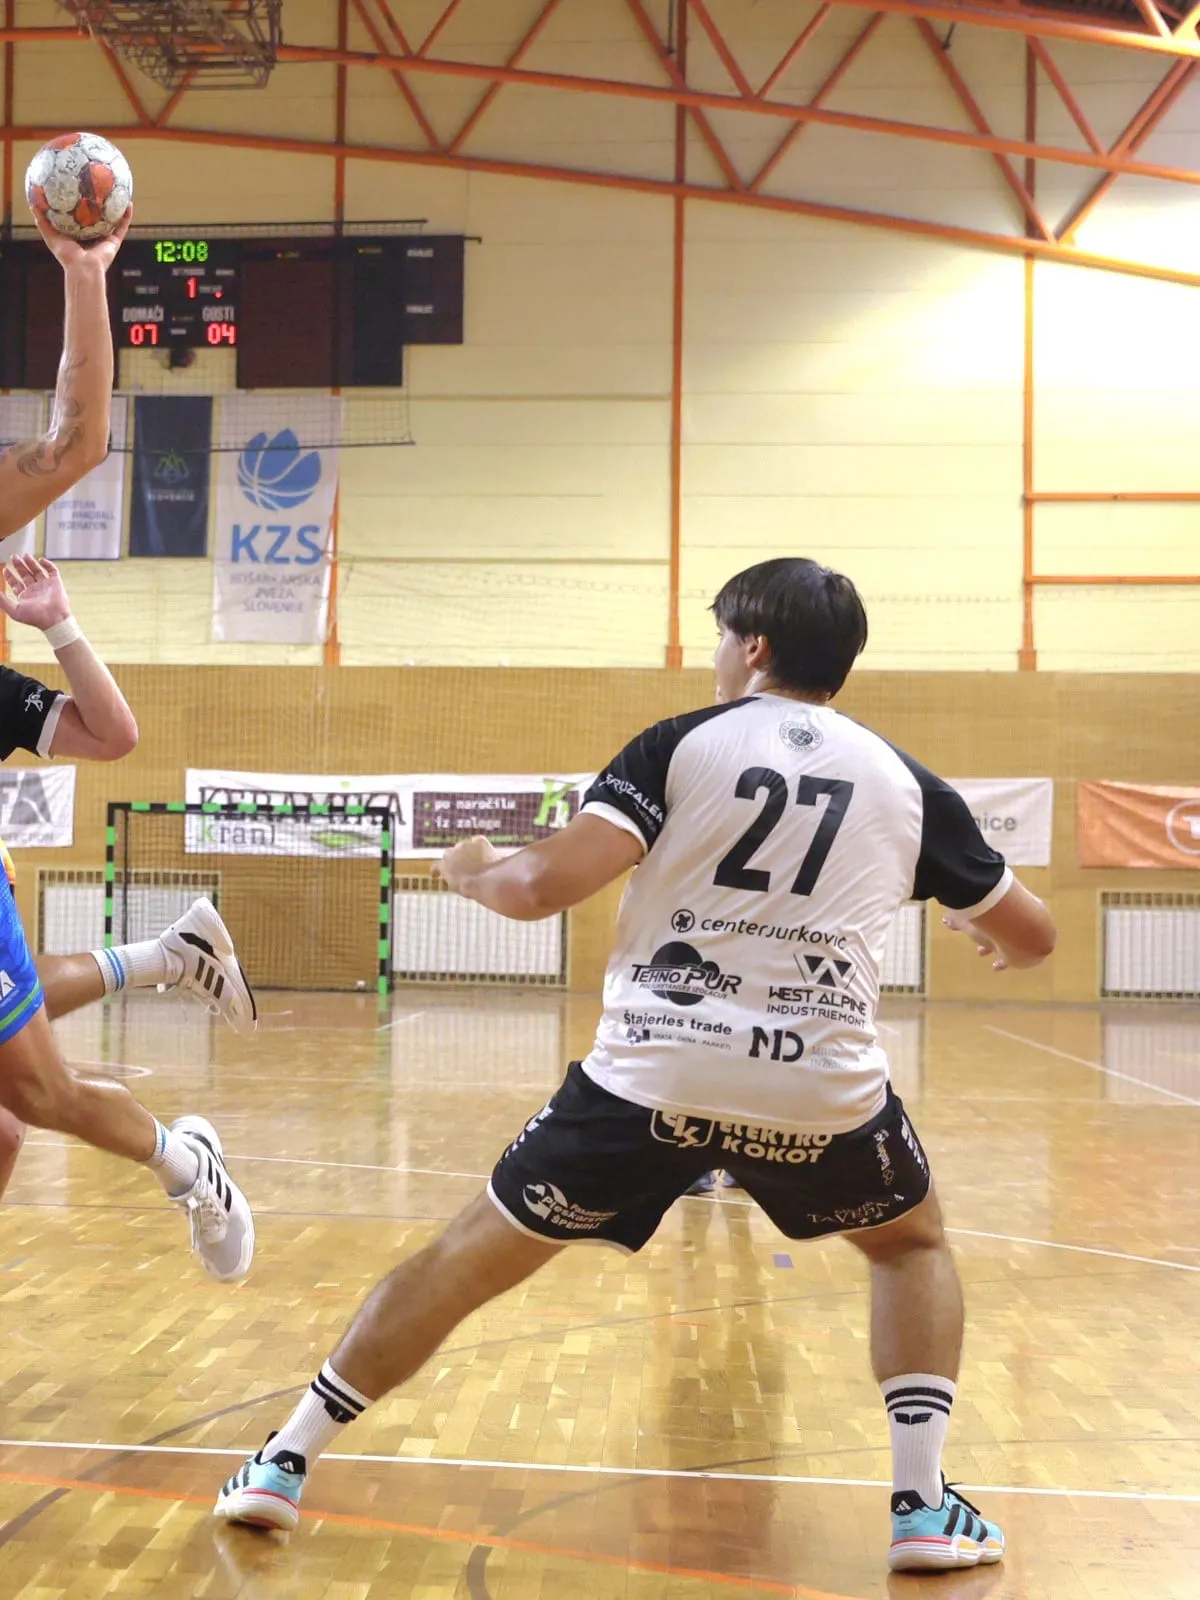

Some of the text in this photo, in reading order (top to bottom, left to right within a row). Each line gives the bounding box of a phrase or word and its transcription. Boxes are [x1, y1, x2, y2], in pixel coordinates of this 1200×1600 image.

[155, 241, 209, 262] 12:08
[187, 277, 198, 298] 1
[130, 323, 158, 345] 07
[207, 323, 236, 345] 04
[231, 524, 322, 565] KZS
[713, 766, 855, 897] 27
[768, 986, 868, 1017] WEST ALPINE
[623, 1010, 733, 1035] Štajerles trade
[766, 1003, 866, 1029] INDUSTRIEMONT
[721, 1135, 824, 1164] KOKOT
